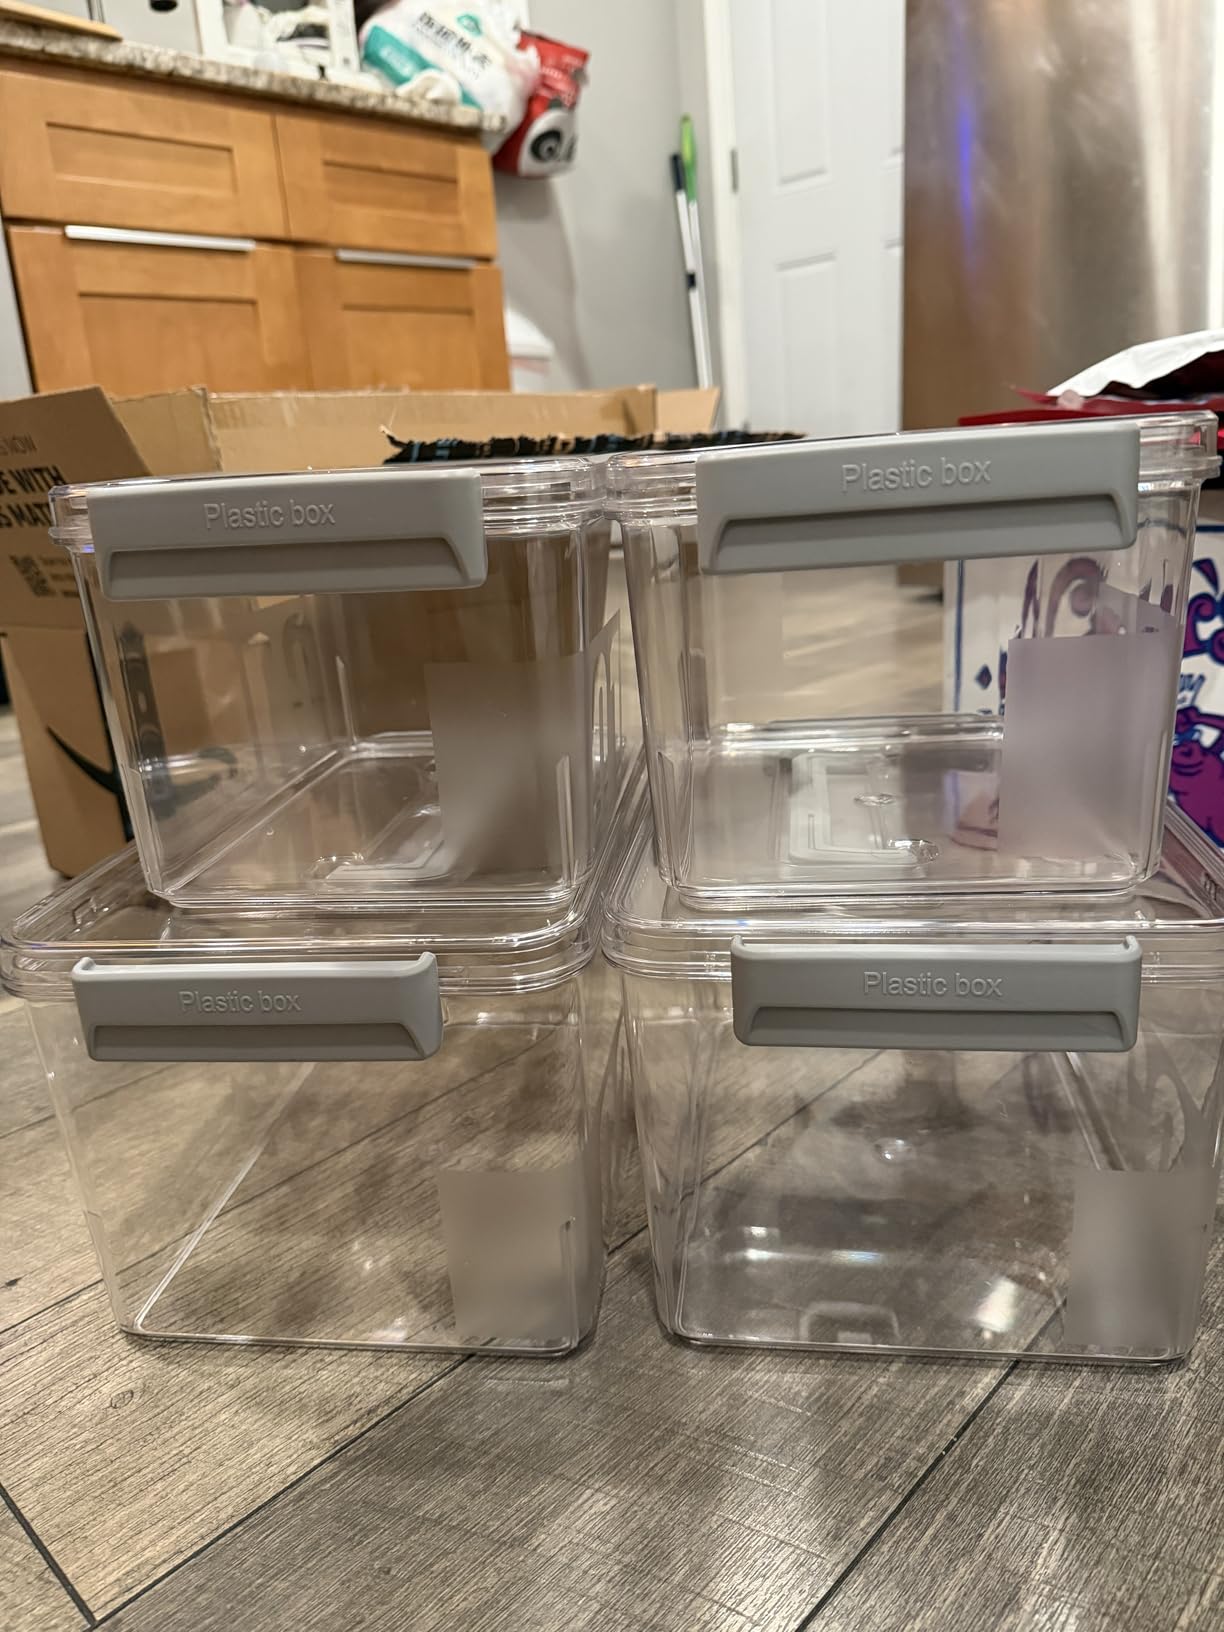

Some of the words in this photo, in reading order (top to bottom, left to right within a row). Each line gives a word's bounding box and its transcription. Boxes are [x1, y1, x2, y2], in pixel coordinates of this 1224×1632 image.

[8, 465, 67, 493] WITH
[841, 459, 933, 493] Plastic
[940, 456, 992, 486] box
[7, 502, 53, 528] MAT
[203, 500, 284, 530] Plastic
[289, 498, 336, 526] box
[863, 971, 948, 996] Plastic
[955, 971, 1003, 996] box
[179, 990, 253, 1012] Plastic
[257, 990, 302, 1012] box
